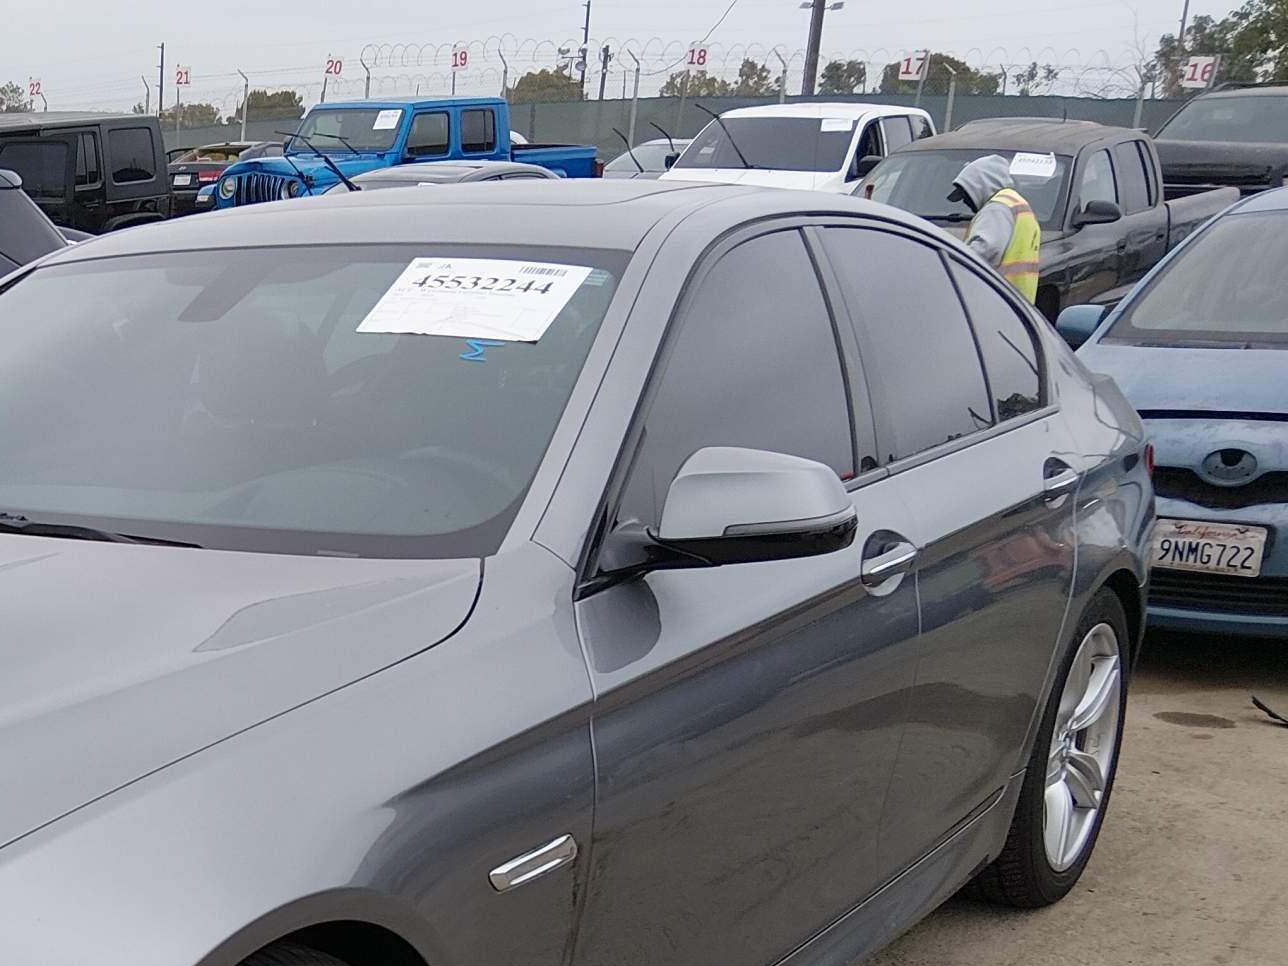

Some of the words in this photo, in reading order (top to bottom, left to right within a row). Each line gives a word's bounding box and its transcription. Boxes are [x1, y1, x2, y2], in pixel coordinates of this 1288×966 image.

[452, 51, 468, 67] 19
[688, 48, 707, 66] 18
[325, 60, 343, 75] 20
[901, 57, 925, 75] 17
[176, 71, 190, 85] 21
[29, 82, 41, 96] 22
[412, 274, 554, 294] 45532244
[1158, 539, 1255, 570] 9NMG722
